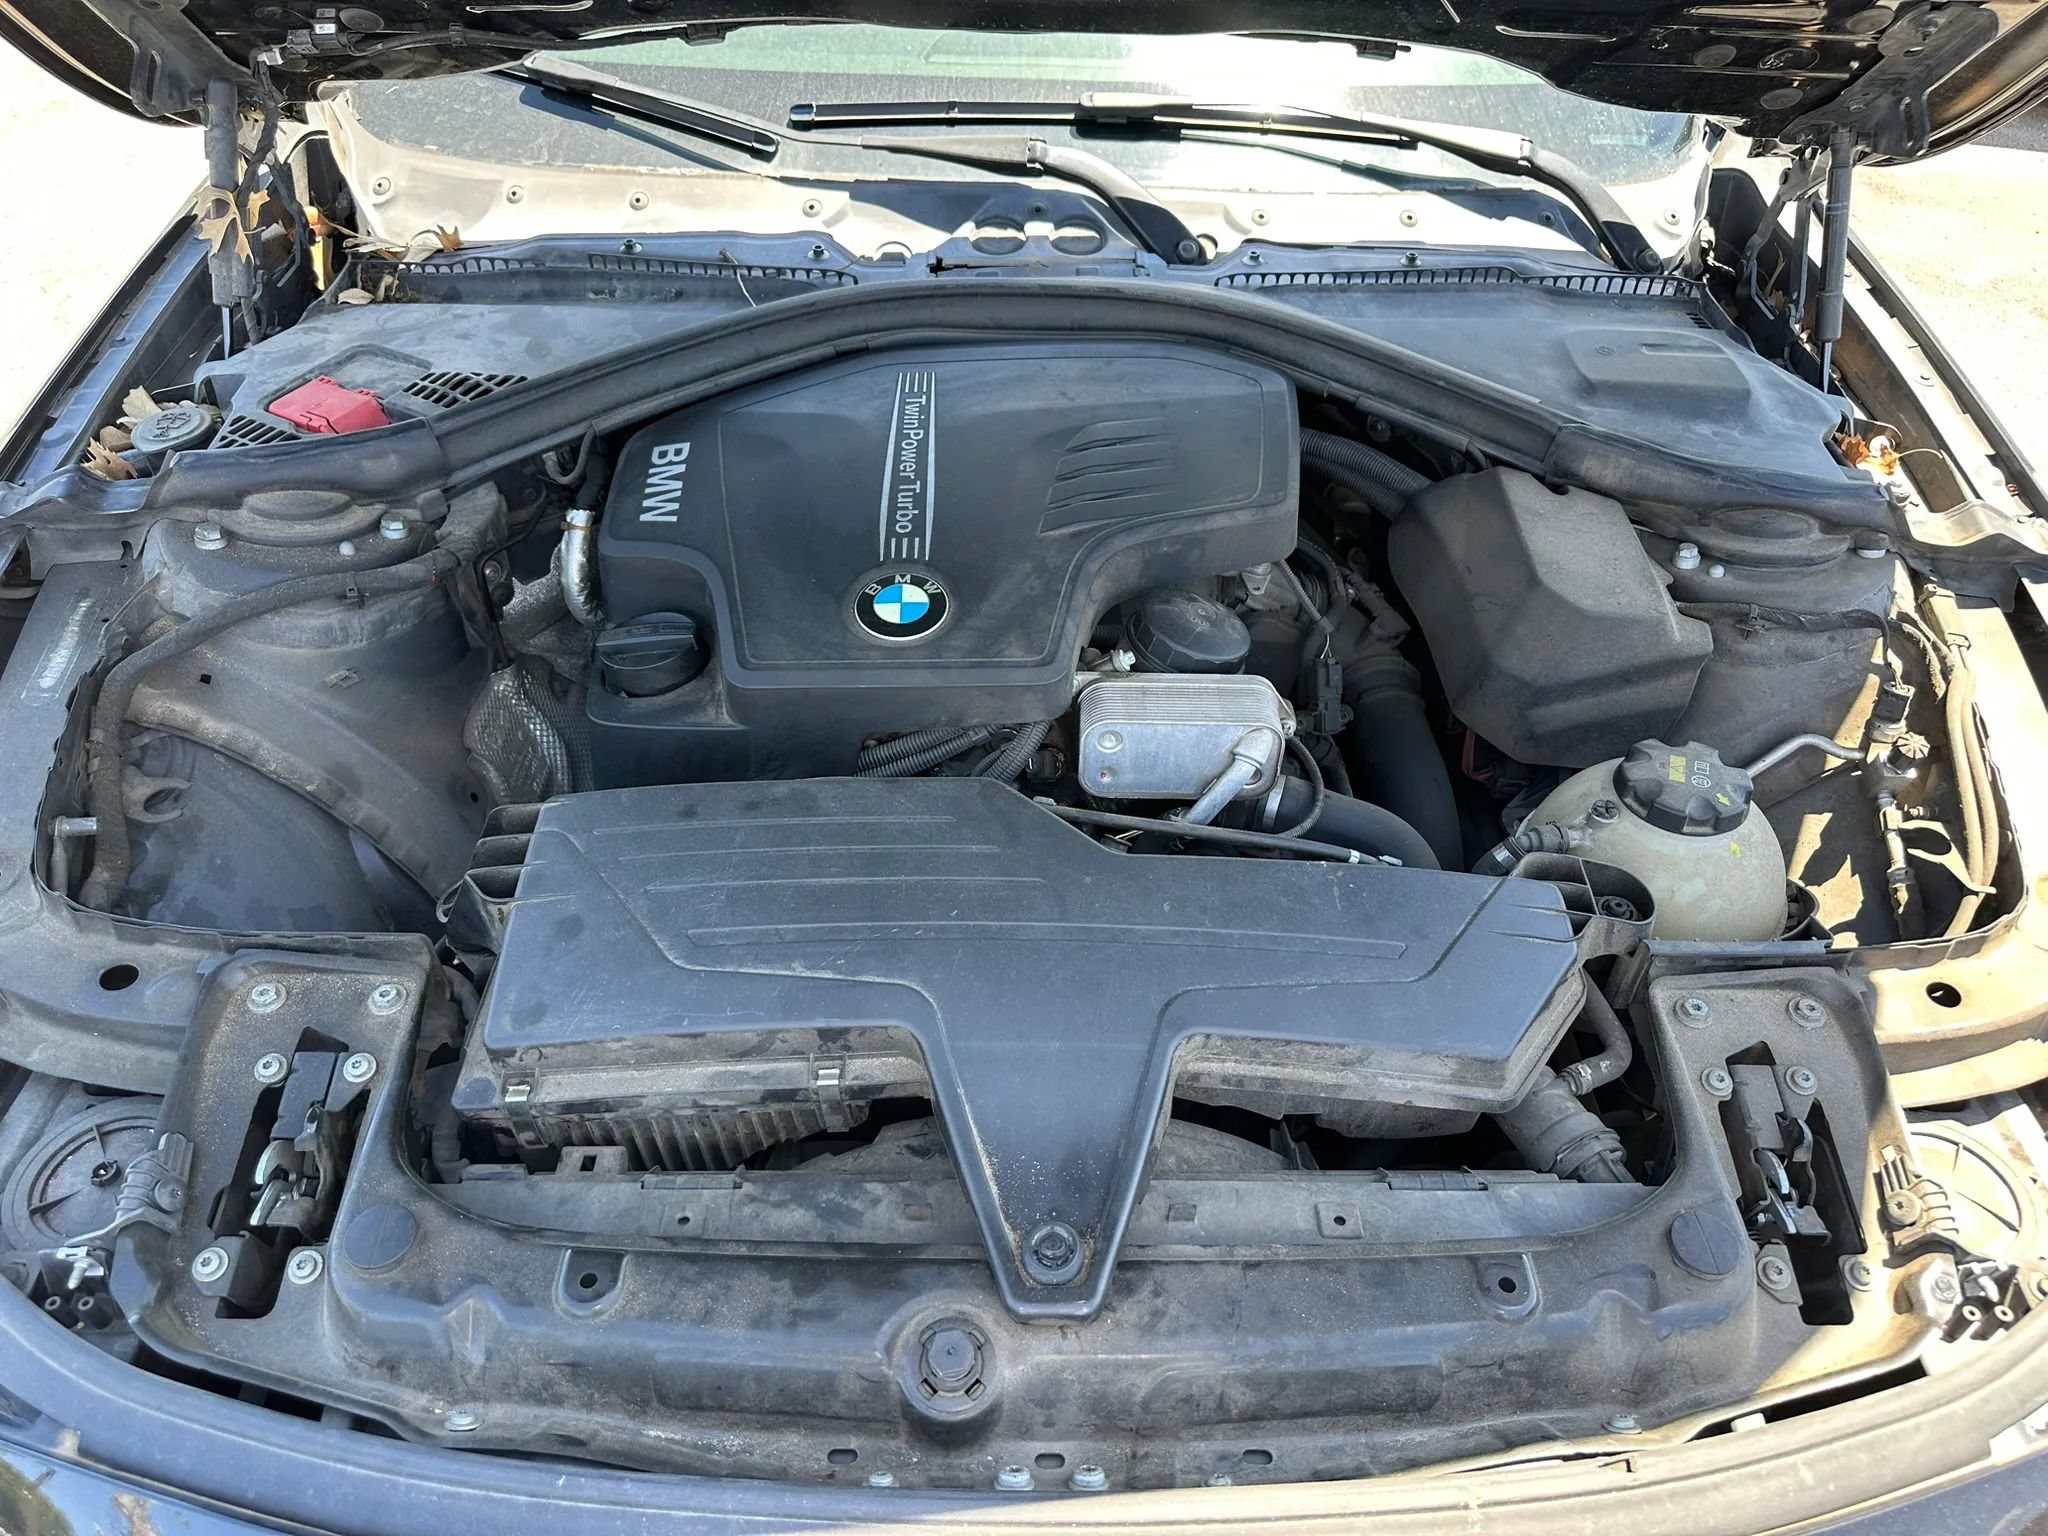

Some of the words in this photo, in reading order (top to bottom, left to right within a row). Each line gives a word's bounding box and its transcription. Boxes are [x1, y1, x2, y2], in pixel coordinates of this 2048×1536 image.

[899, 395, 926, 480] TwinPower
[640, 441, 691, 522] BMW
[895, 481, 921, 534] Turbo
[864, 574, 941, 596] BMW
